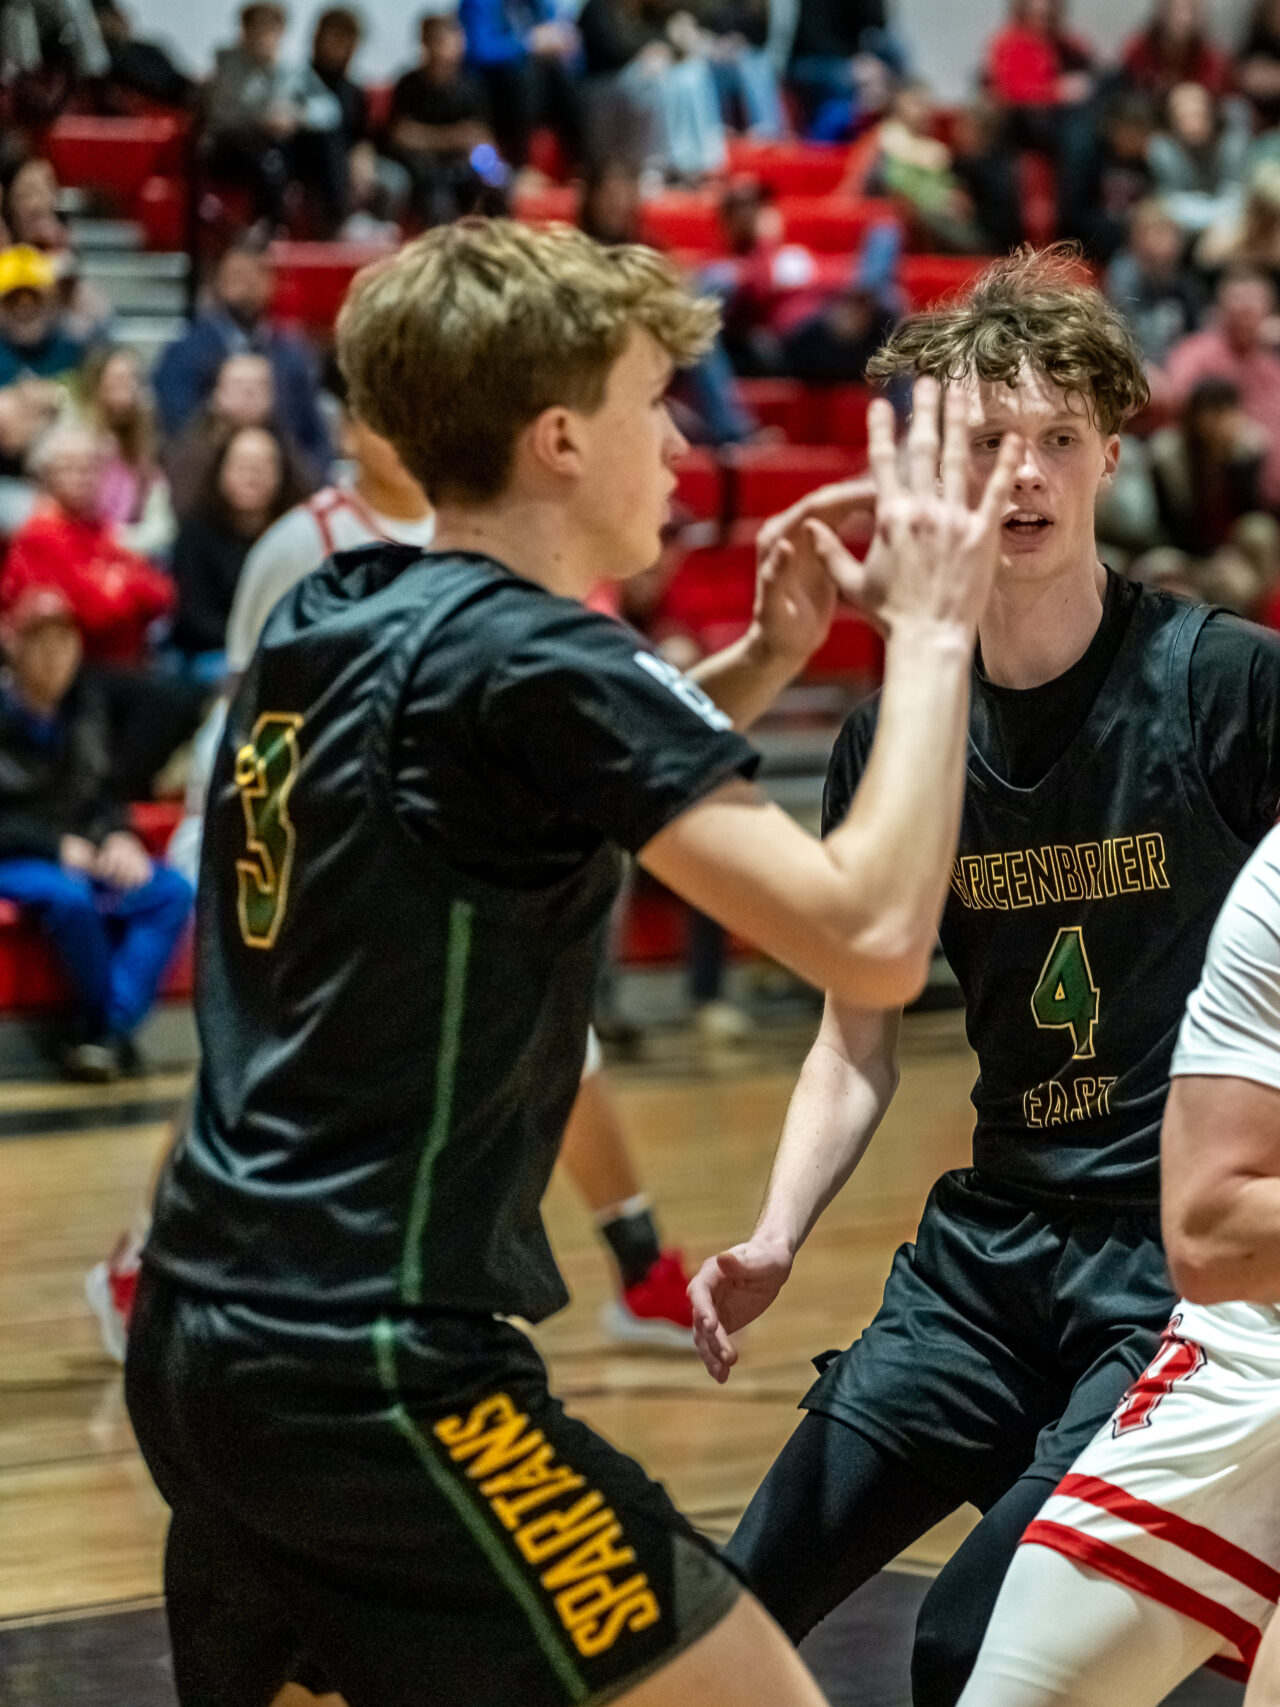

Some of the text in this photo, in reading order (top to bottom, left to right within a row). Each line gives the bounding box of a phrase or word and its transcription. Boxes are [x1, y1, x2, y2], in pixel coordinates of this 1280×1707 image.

[235, 711, 304, 950] 3
[949, 832, 1171, 910] GREENBRIER
[1031, 926, 1100, 1060] 4
[432, 1392, 661, 1658] SPARTANS
